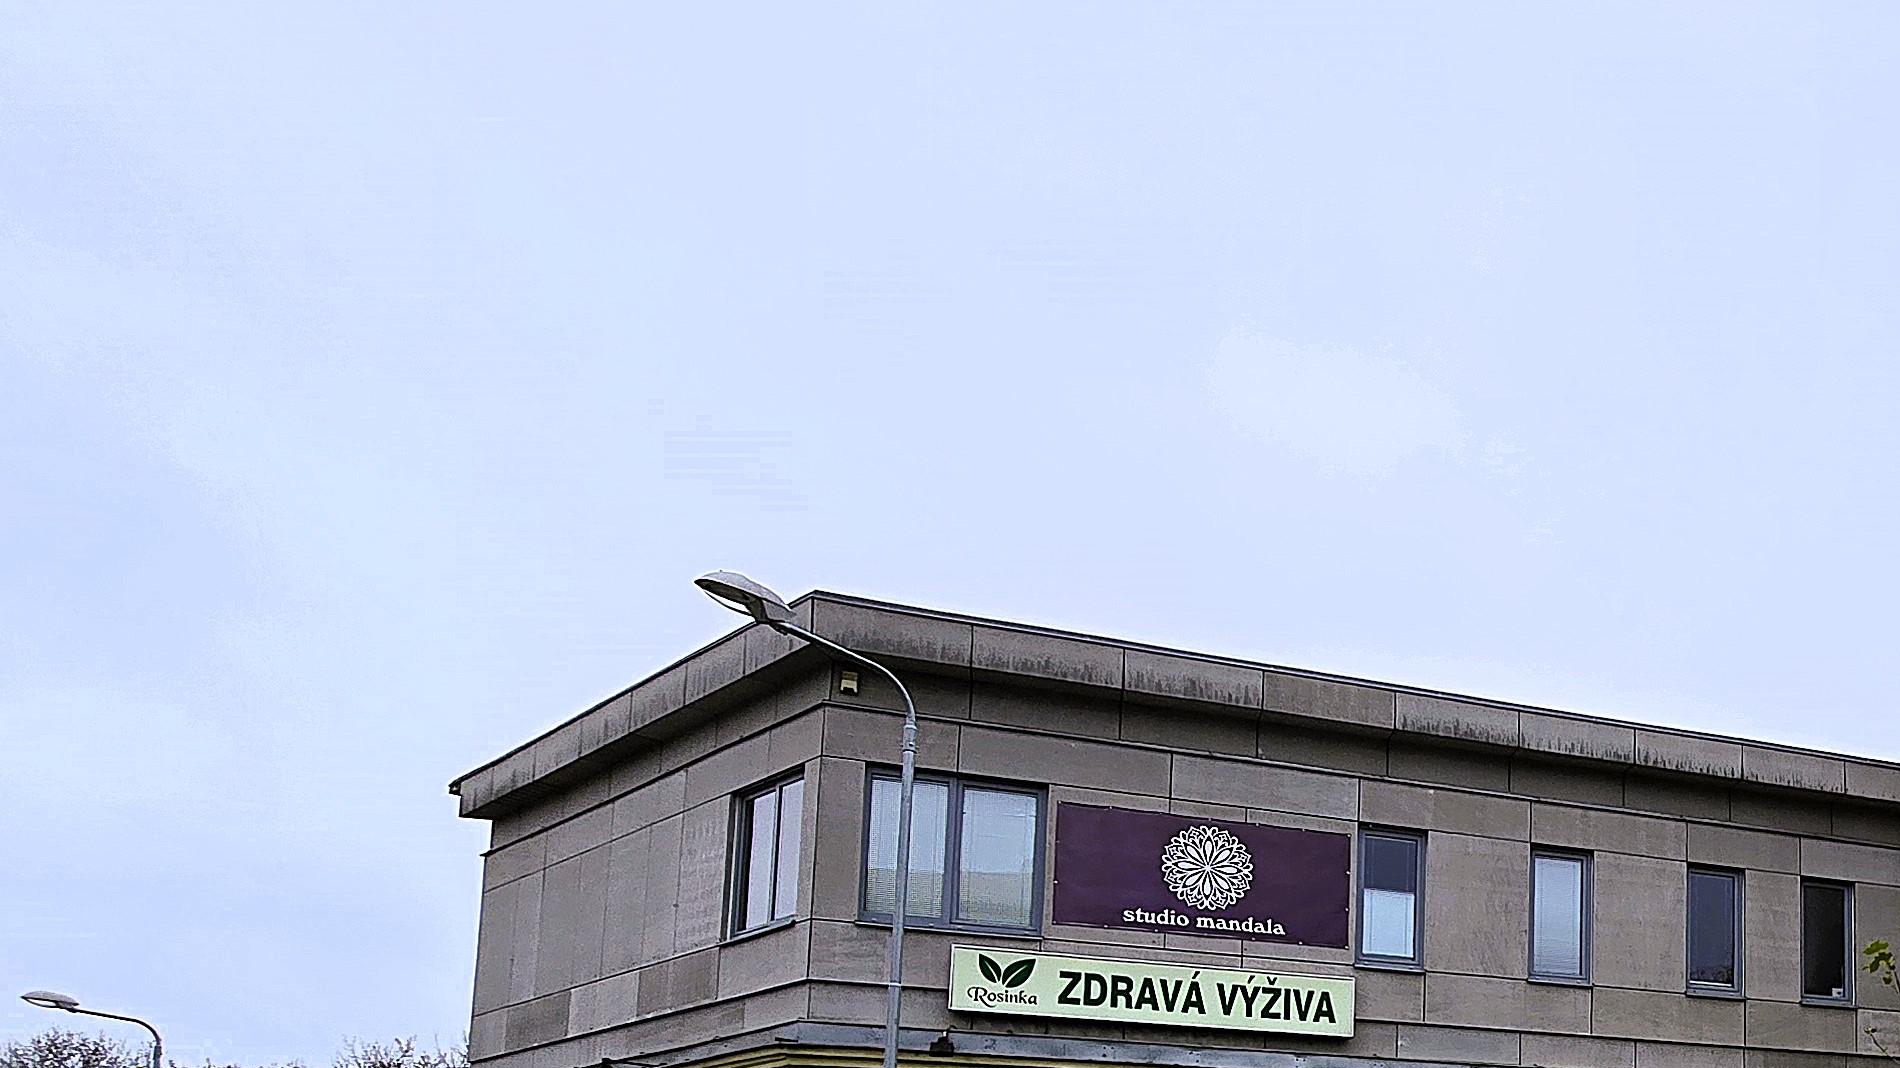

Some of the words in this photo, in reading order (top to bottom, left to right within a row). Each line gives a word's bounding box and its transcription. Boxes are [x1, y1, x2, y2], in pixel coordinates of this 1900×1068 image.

[1123, 907, 1190, 926] studio
[1196, 916, 1286, 936] mandala
[967, 986, 1038, 1008] Rosinka
[1057, 971, 1206, 1014] ZDRAVÁ
[1217, 975, 1337, 1024] VÝŽIVA
